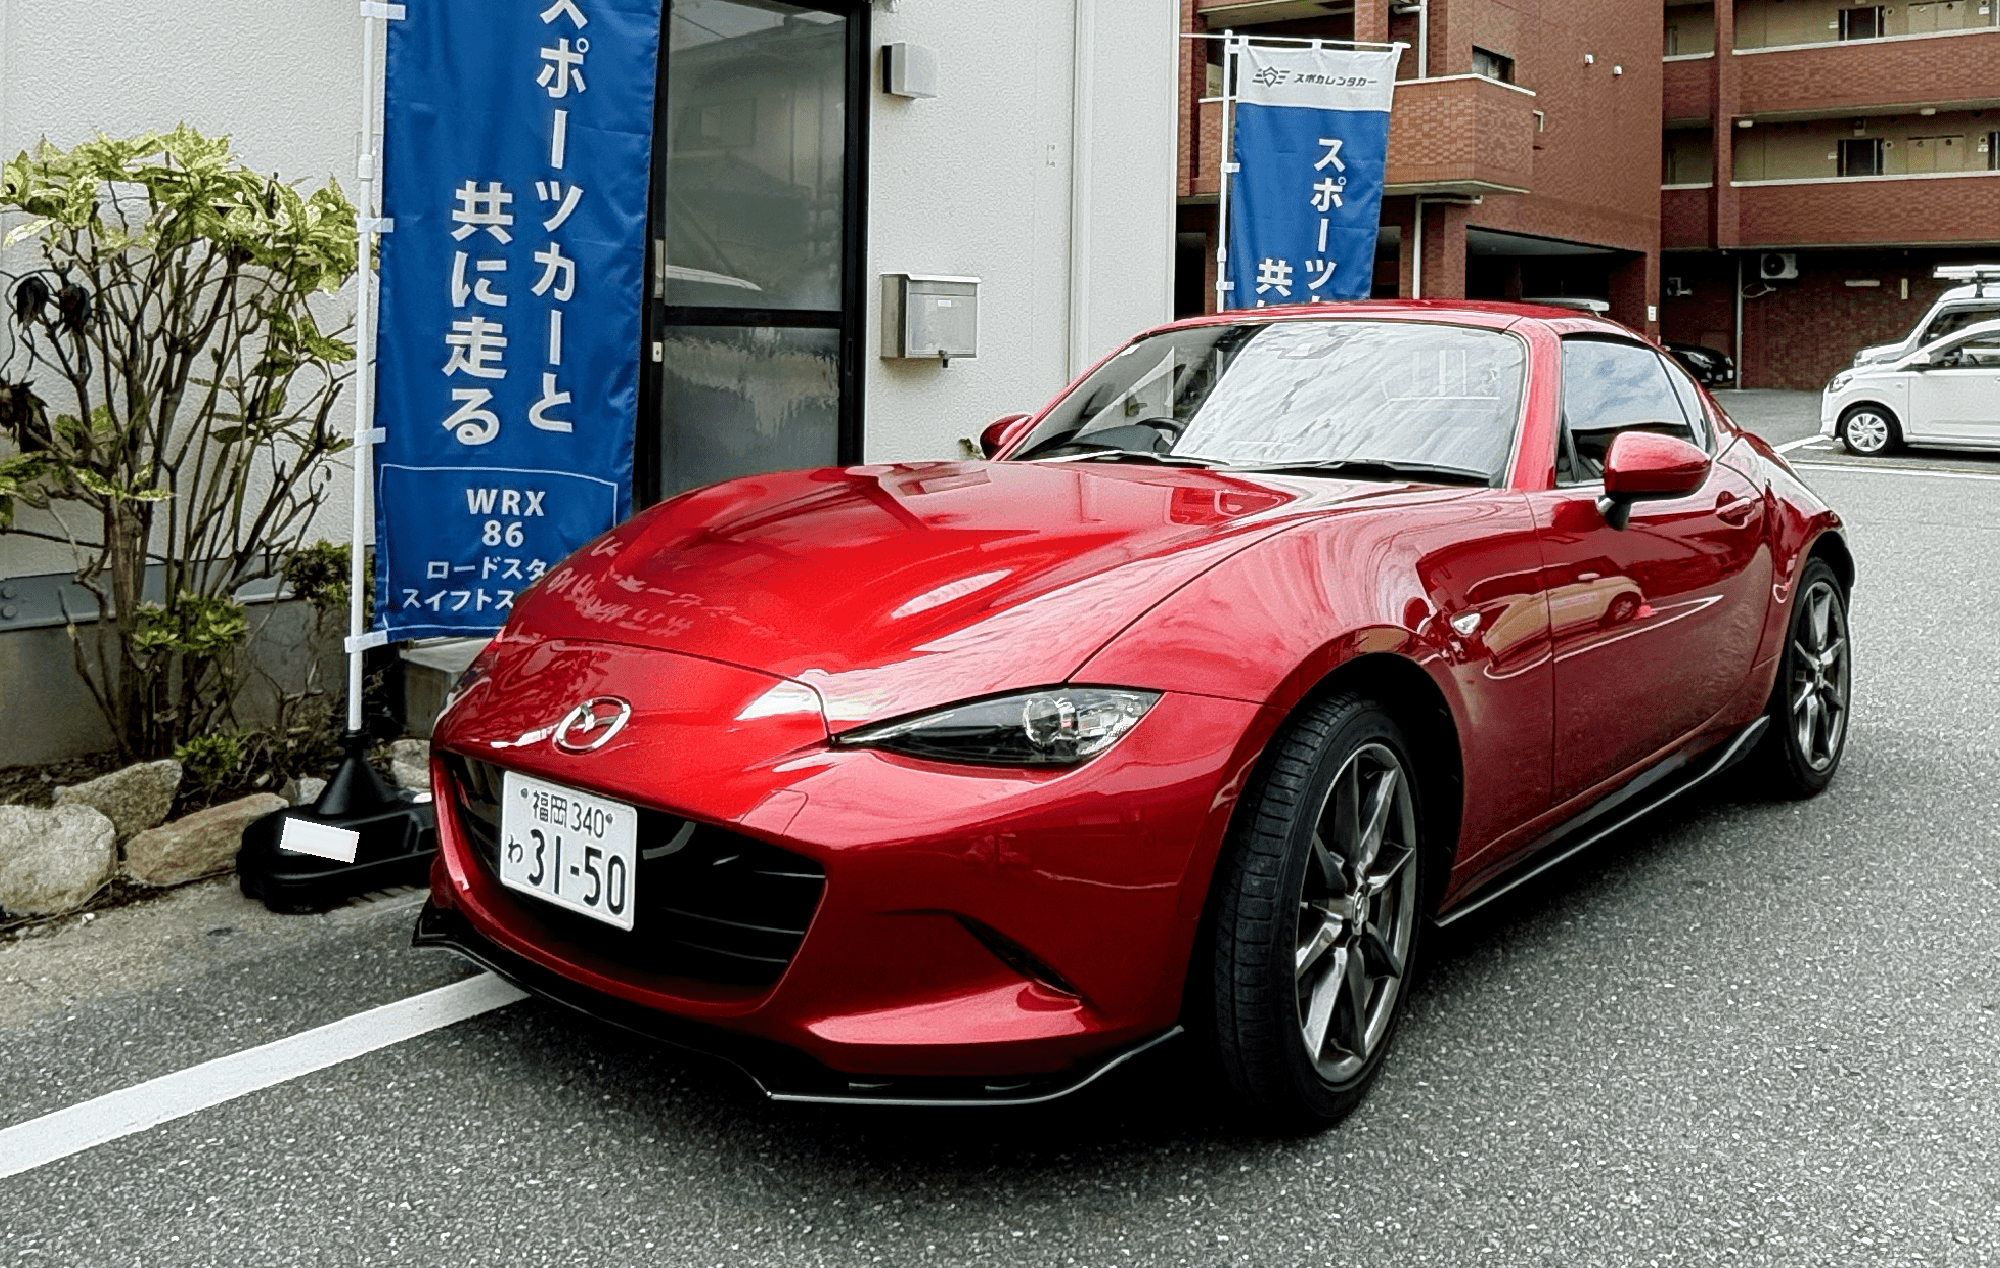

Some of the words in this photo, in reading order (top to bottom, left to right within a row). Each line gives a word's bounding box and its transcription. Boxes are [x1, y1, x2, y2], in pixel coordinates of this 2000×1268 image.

[1305, 138, 1347, 303] スポーツ
[1256, 258, 1293, 308] 共
[441, 180, 514, 446] 共に走る
[466, 488, 546, 517] WRX
[481, 520, 524, 548] 86
[533, 790, 567, 828] 福岡
[570, 802, 605, 839] 340
[507, 834, 523, 863] わ
[528, 828, 626, 915] 31-50
